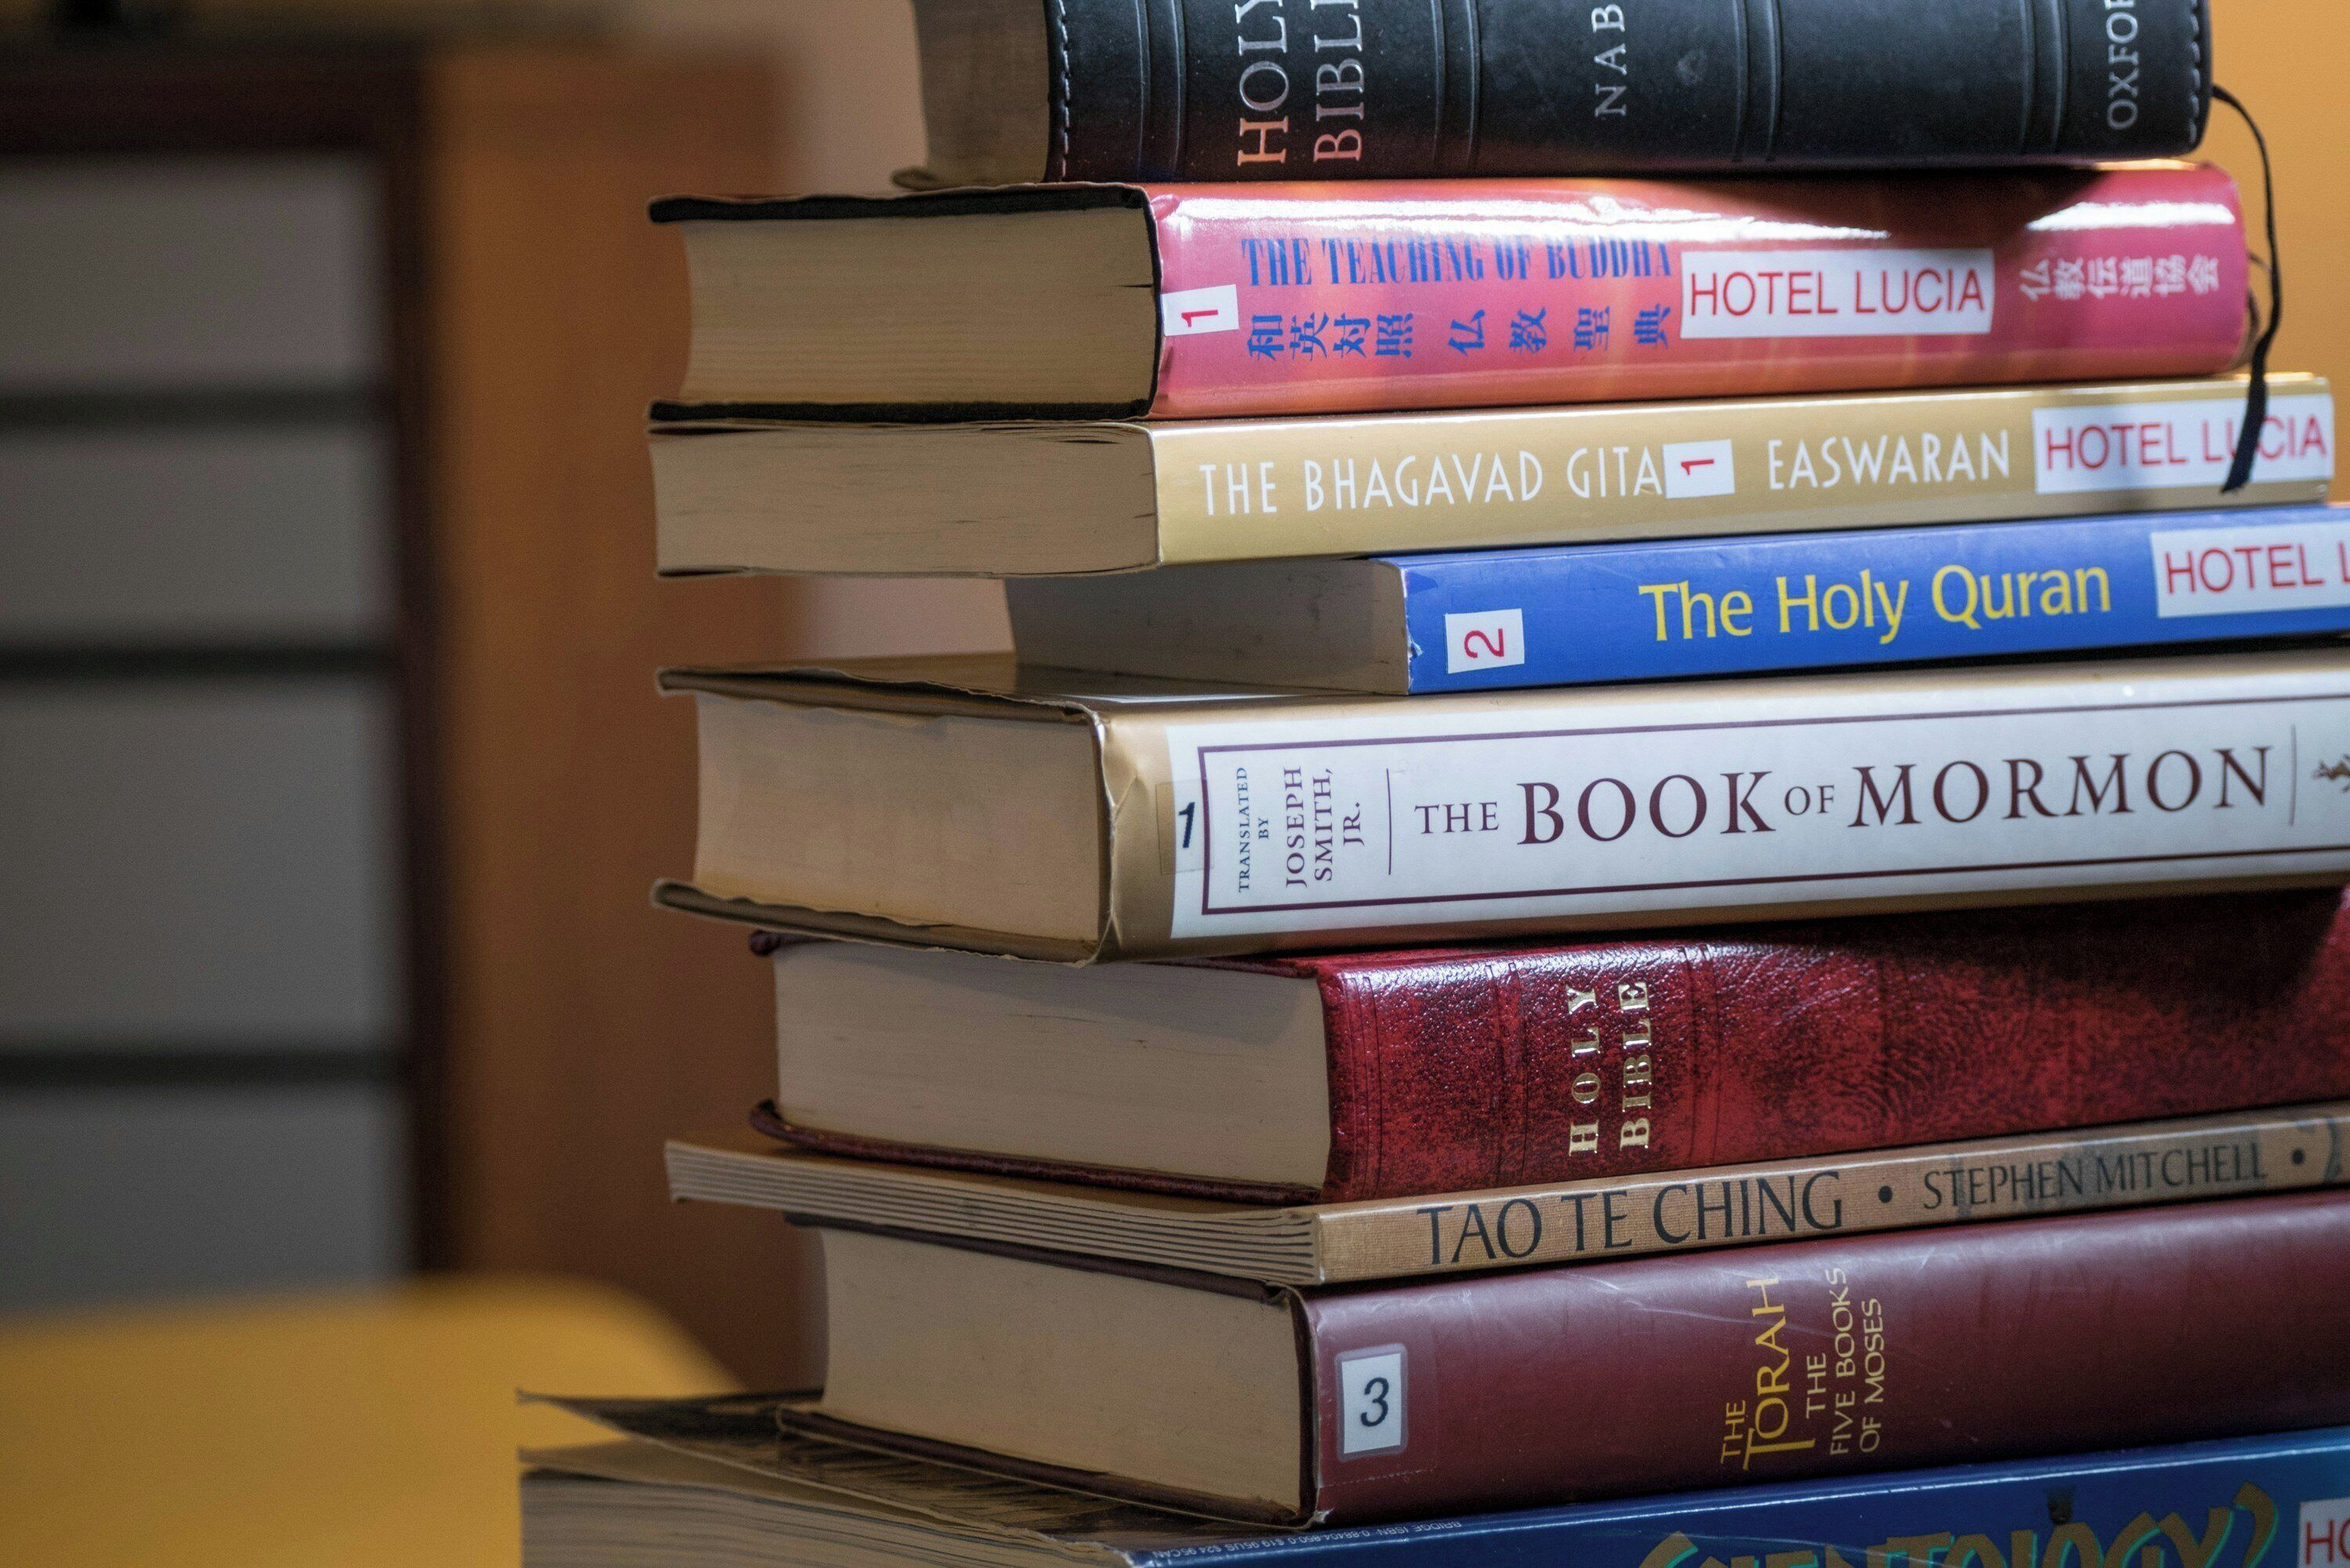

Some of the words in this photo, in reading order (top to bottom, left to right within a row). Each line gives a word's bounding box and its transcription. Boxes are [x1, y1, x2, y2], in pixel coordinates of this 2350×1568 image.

[1591, 4, 1627, 117] NAB
[1242, 237, 1313, 287] THE
[1321, 233, 1484, 284] TEACHING
[1495, 233, 1532, 281] OF
[1545, 233, 1672, 280] BUDDHA
[1691, 270, 1838, 316] HOTEL
[1855, 268, 1984, 313] LUCIA
[2019, 253, 2218, 301] 仏教伝道協会
[1180, 309, 1218, 327] 1
[1246, 311, 1413, 361] 和英対照
[1448, 303, 1671, 356] 仏教聖典
[1680, 458, 1715, 475] 1
[1768, 430, 2009, 490] EASWARAN
[2045, 421, 2187, 471] HOTEL
[1199, 461, 1277, 516] THE
[1304, 450, 1543, 511] BHAGAVAD
[1567, 446, 1663, 498] GITA
[2165, 543, 2325, 594] HOTEL
[1639, 580, 1753, 641] The
[1776, 569, 1909, 645] Holy
[1932, 563, 2111, 629] Quran
[1464, 627, 1504, 659] 2
[1178, 801, 1195, 849] 1
[1283, 766, 1308, 889] JOSEPH
[1313, 768, 1333, 882] SMITH,
[1343, 802, 1365, 846] JR.
[1414, 800, 1499, 834] THE
[1517, 770, 1776, 845] BOOK
[1784, 784, 1835, 816] OF
[1848, 746, 2272, 828] MORMON
[1236, 767, 1250, 893] TRANSLATED
[1258, 817, 1269, 840] BY
[1567, 984, 1601, 1156] HOLY
[1618, 981, 1651, 1151] BIBLE
[1923, 1158, 2083, 1210] STEPHEN
[2095, 1141, 2269, 1194] MITCHELL
[1416, 1198, 1542, 1265] TAO
[1561, 1190, 1632, 1251] TE
[1653, 1170, 1843, 1245] CHING
[1825, 1268, 1856, 1378] BOOKS
[1861, 1299, 1885, 1404] MOSES
[1360, 1377, 1390, 1427] 3
[1742, 1274, 1816, 1471] TORAH
[1806, 1353, 1827, 1418] THE
[1720, 1400, 1745, 1464] THE
[1829, 1390, 1855, 1455] FIVE
[1860, 1416, 1882, 1453] OF
[1415, 1521, 1462, 1532] BRIDGE
